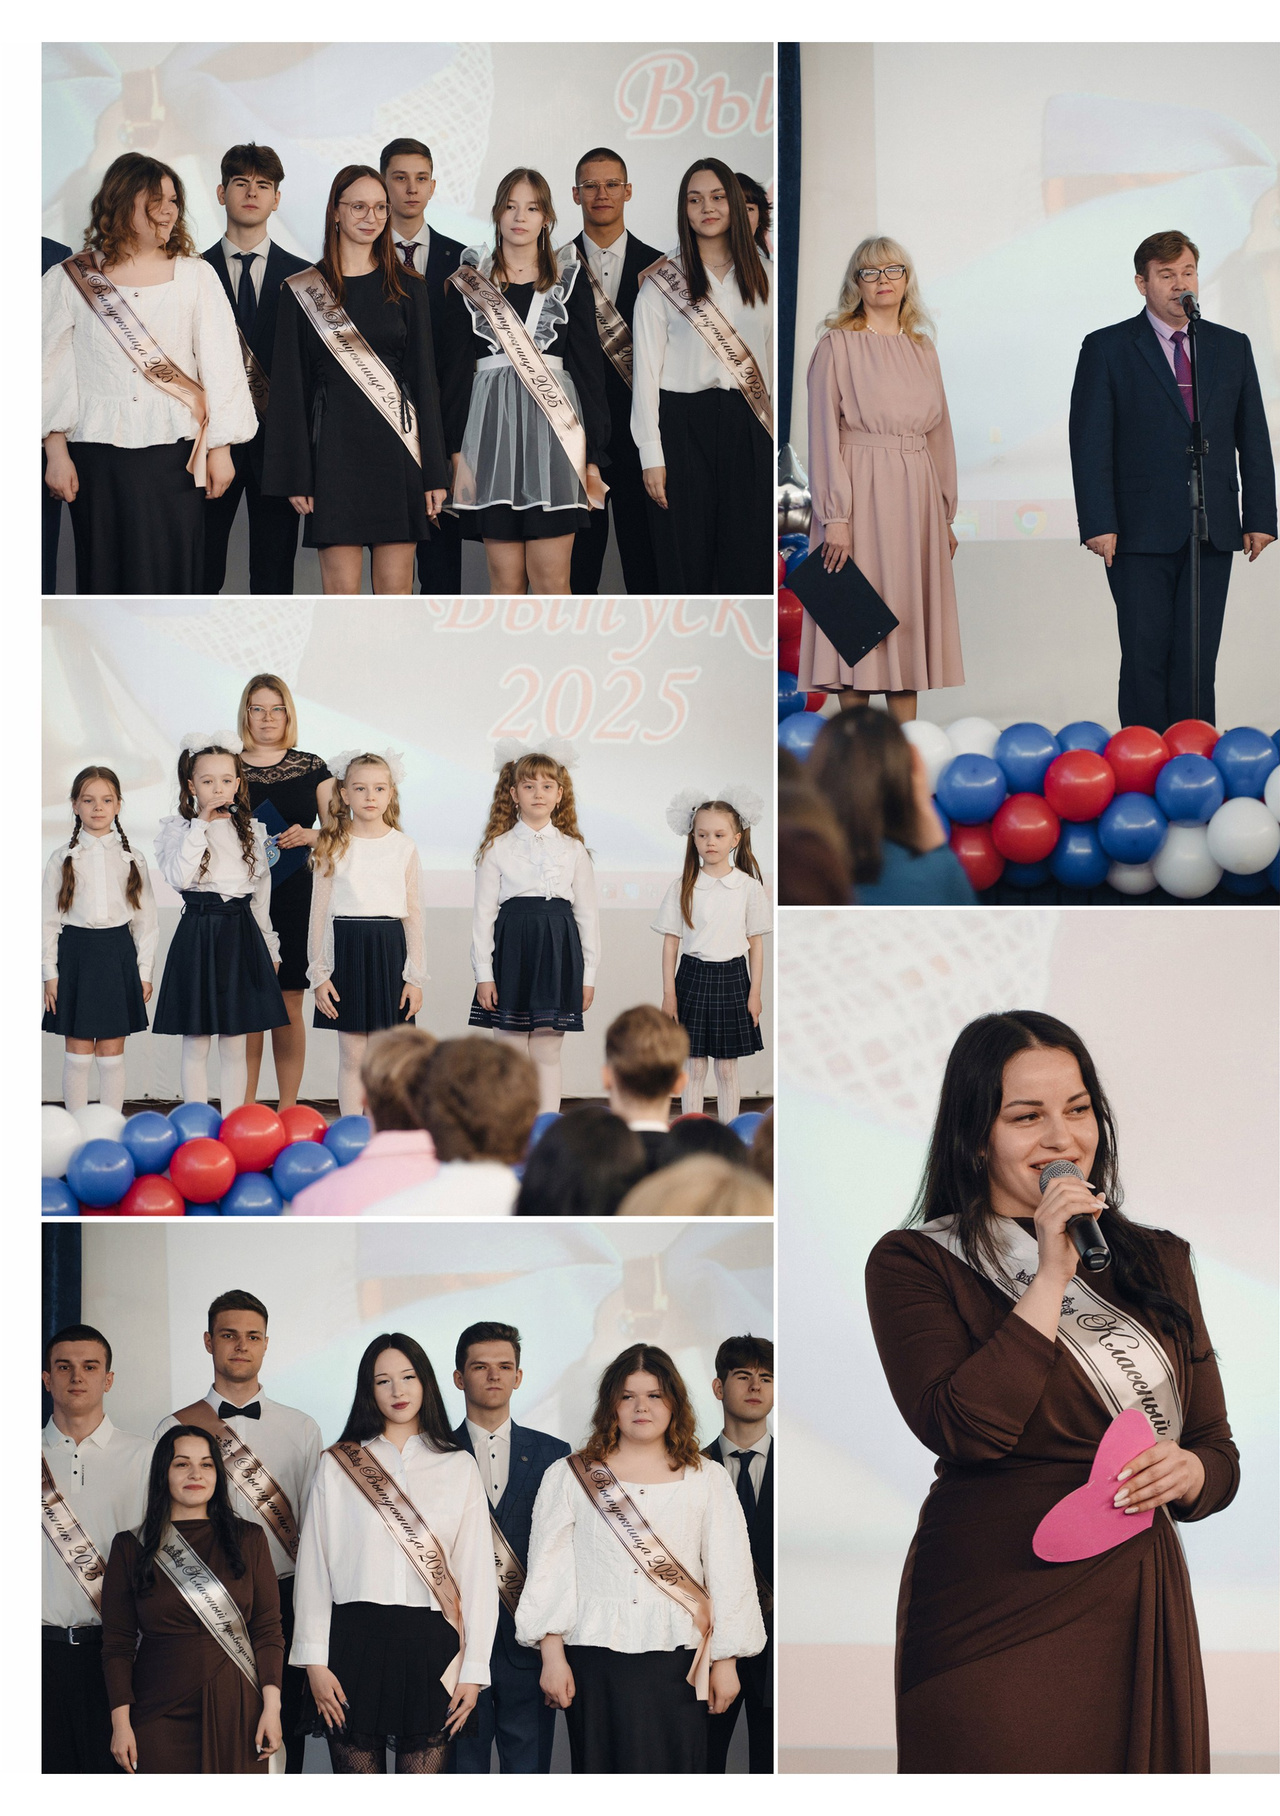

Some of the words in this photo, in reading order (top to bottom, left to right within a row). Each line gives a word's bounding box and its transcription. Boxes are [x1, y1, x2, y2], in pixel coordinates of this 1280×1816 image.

[87, 275, 147, 356] Выпускница
[143, 356, 179, 384] 2025
[322, 309, 386, 392] Выпускница
[479, 290, 536, 374] Выпускница
[530, 374, 564, 408] 2025
[739, 366, 766, 400] 2025
[487, 663, 702, 745] 2025
[1076, 1313, 1170, 1437] Классный
[234, 1457, 292, 1535] Выпускник
[359, 1466, 425, 1551] Выпускница
[418, 1550, 447, 1586] 2025
[590, 1469, 652, 1556] Выпускница
[646, 1555, 685, 1586] 2025
[68, 1545, 105, 1581] 2025
[182, 1565, 227, 1620] Классный
